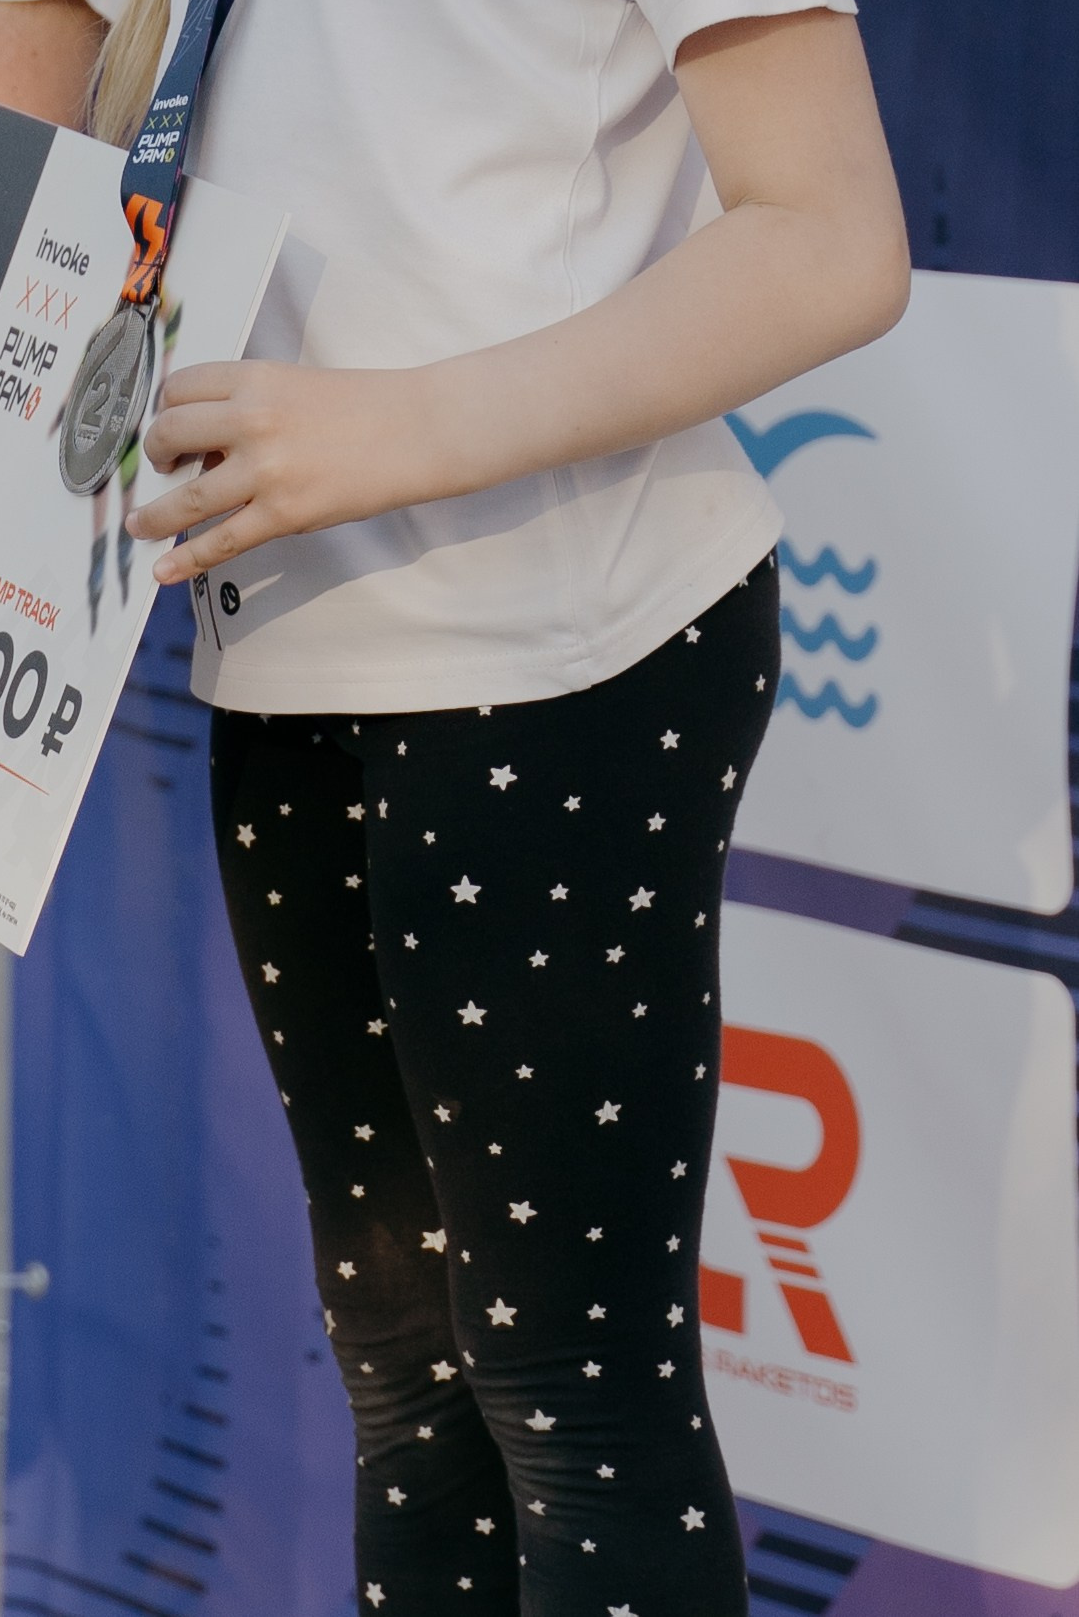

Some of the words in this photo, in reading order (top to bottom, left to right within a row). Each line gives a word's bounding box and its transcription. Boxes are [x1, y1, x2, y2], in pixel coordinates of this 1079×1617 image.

[152, 94, 189, 111] invoke
[137, 130, 180, 148] PUMP
[132, 148, 166, 164] JAM
[35, 228, 90, 276] invoke
[0, 325, 59, 377] PUMP
[15, 588, 61, 632] TRACK
